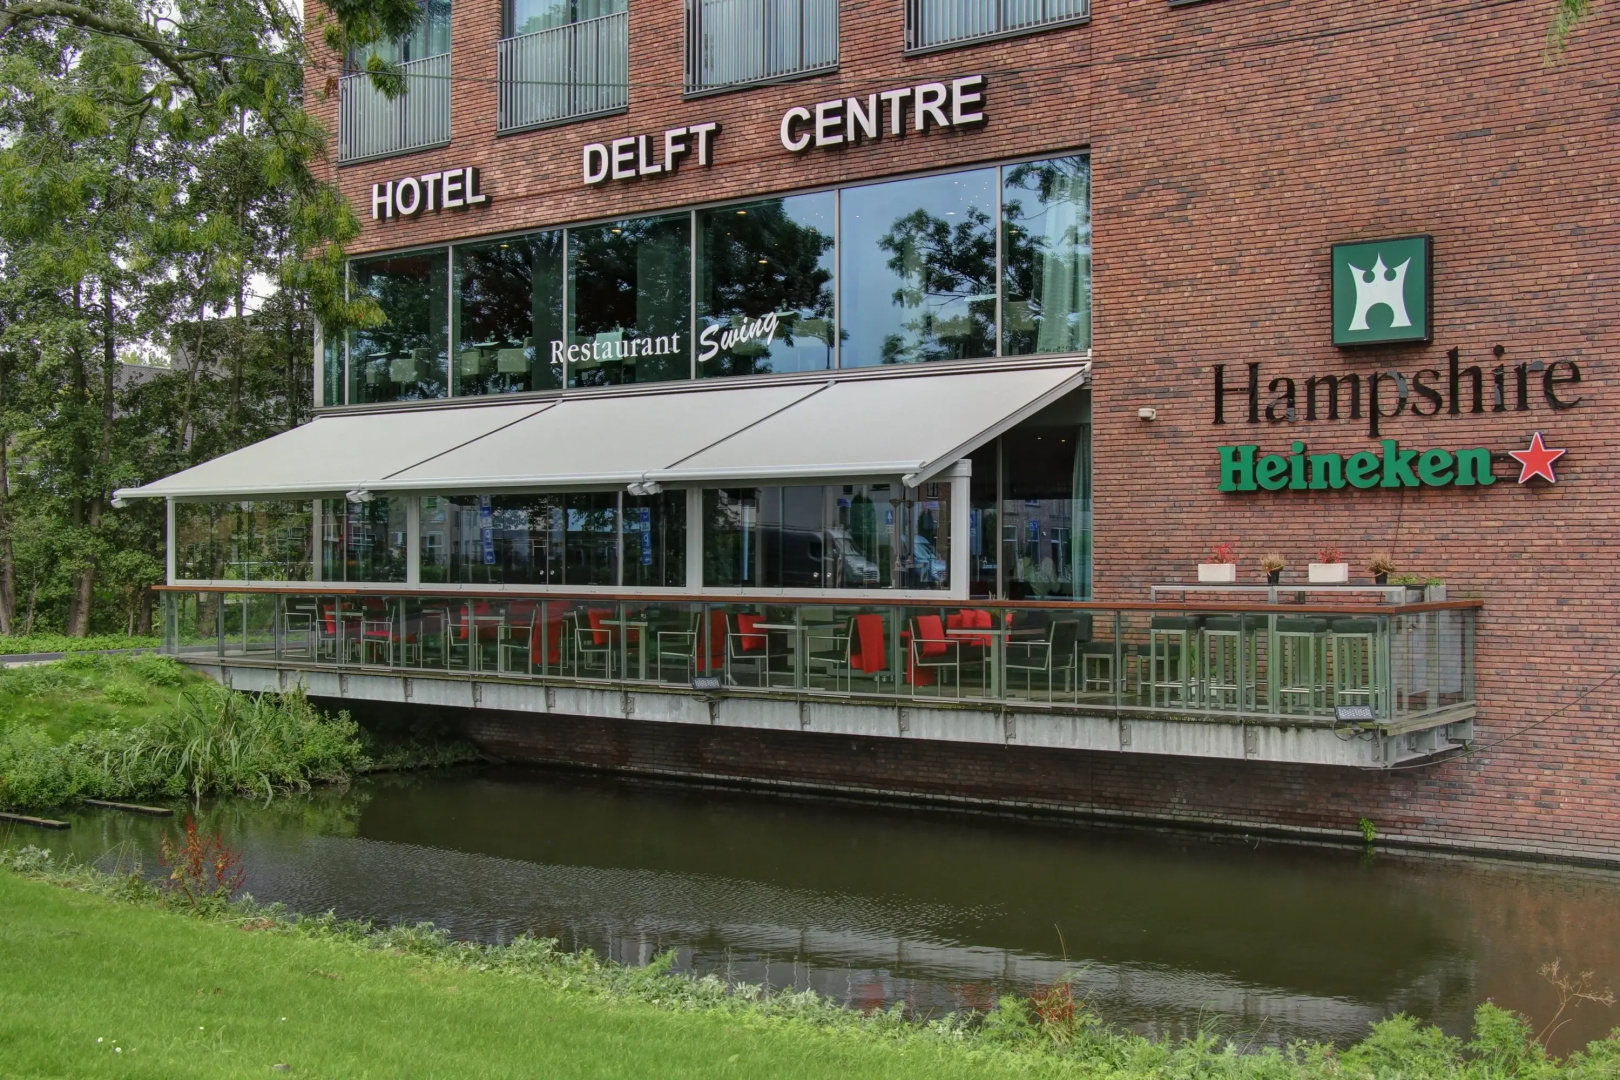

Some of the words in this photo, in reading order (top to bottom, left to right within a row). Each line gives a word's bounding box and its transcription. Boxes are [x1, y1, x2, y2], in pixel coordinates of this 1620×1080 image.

[372, 167, 487, 220] HOTEL
[583, 122, 718, 185] DELFT
[780, 74, 984, 151] CENTRE
[550, 331, 682, 365] Restaurant
[698, 311, 780, 362] Swing
[1211, 344, 1583, 438] Hampshire
[1216, 439, 1496, 492] Heineken
